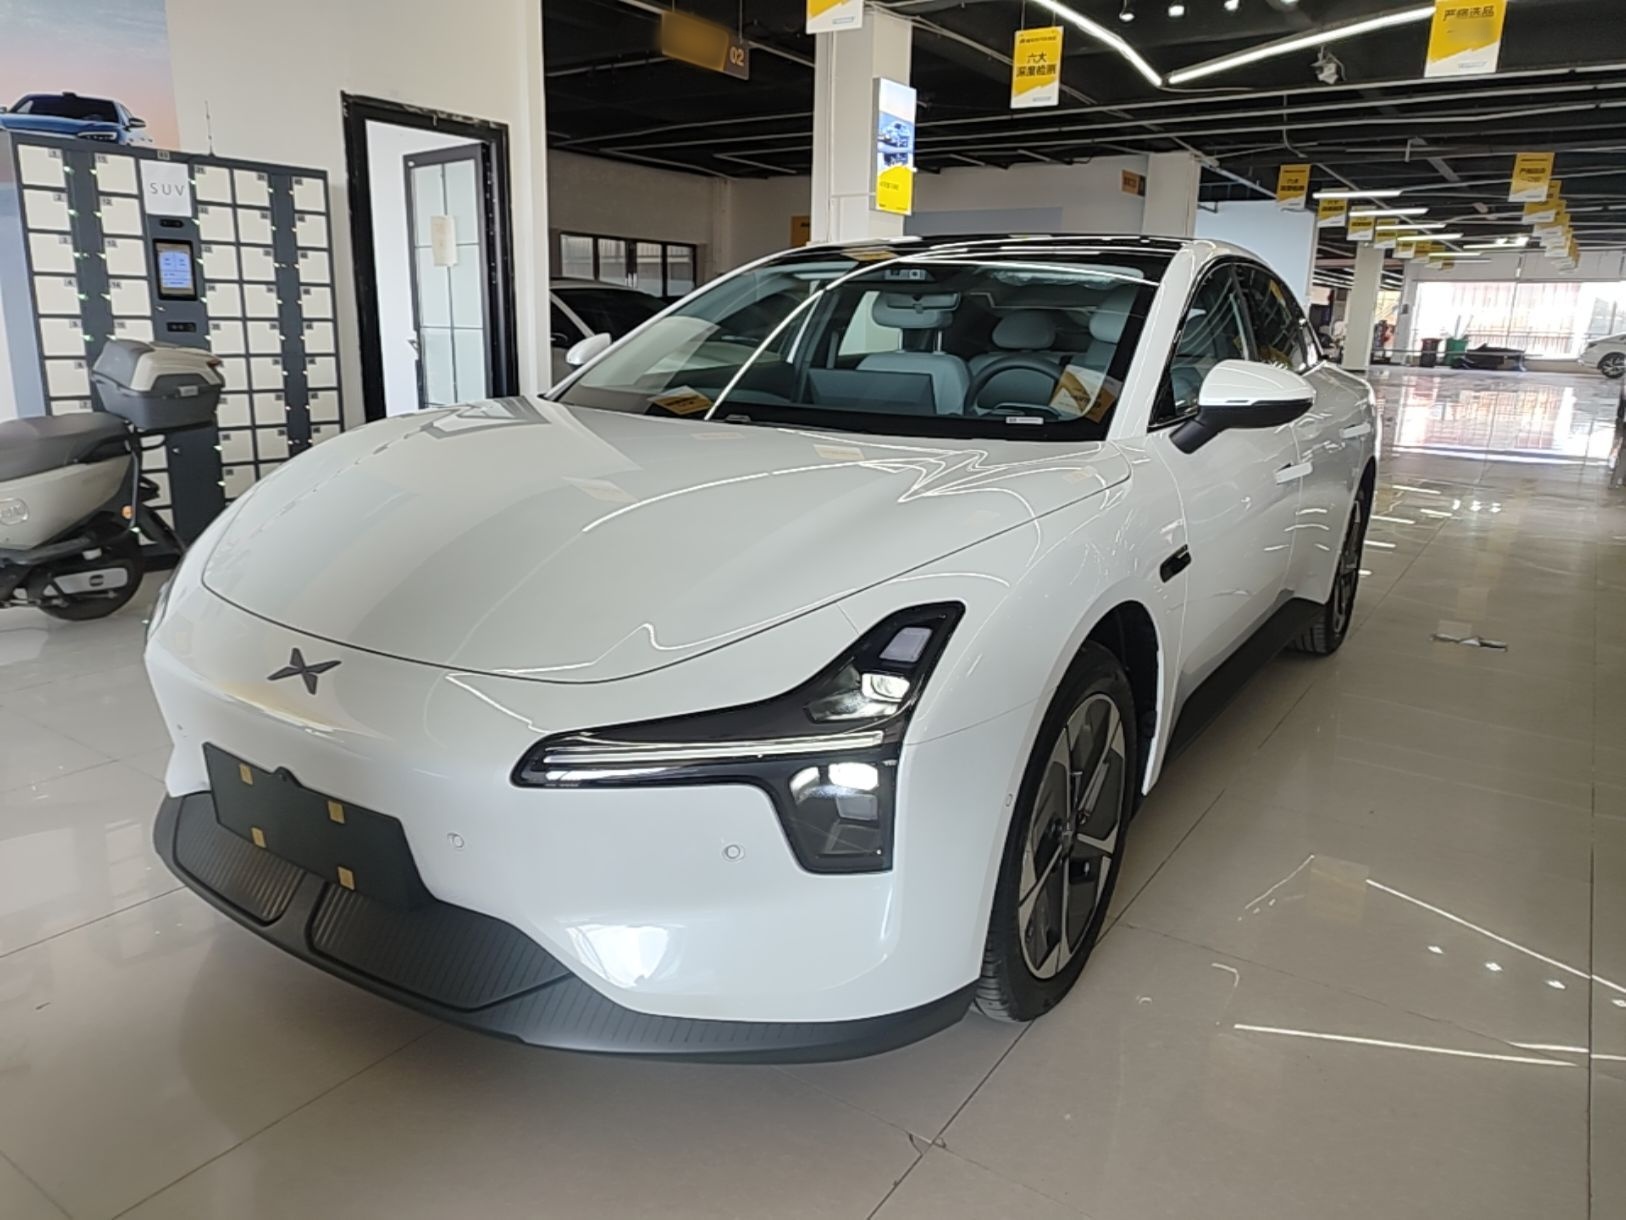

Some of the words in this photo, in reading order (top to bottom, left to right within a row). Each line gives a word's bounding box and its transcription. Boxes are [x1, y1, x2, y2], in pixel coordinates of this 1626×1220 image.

[1443, 5, 1494, 21] 严格选品
[729, 46, 745, 67] 02
[1027, 52, 1047, 64] 六大
[149, 182, 185, 197] SUV
